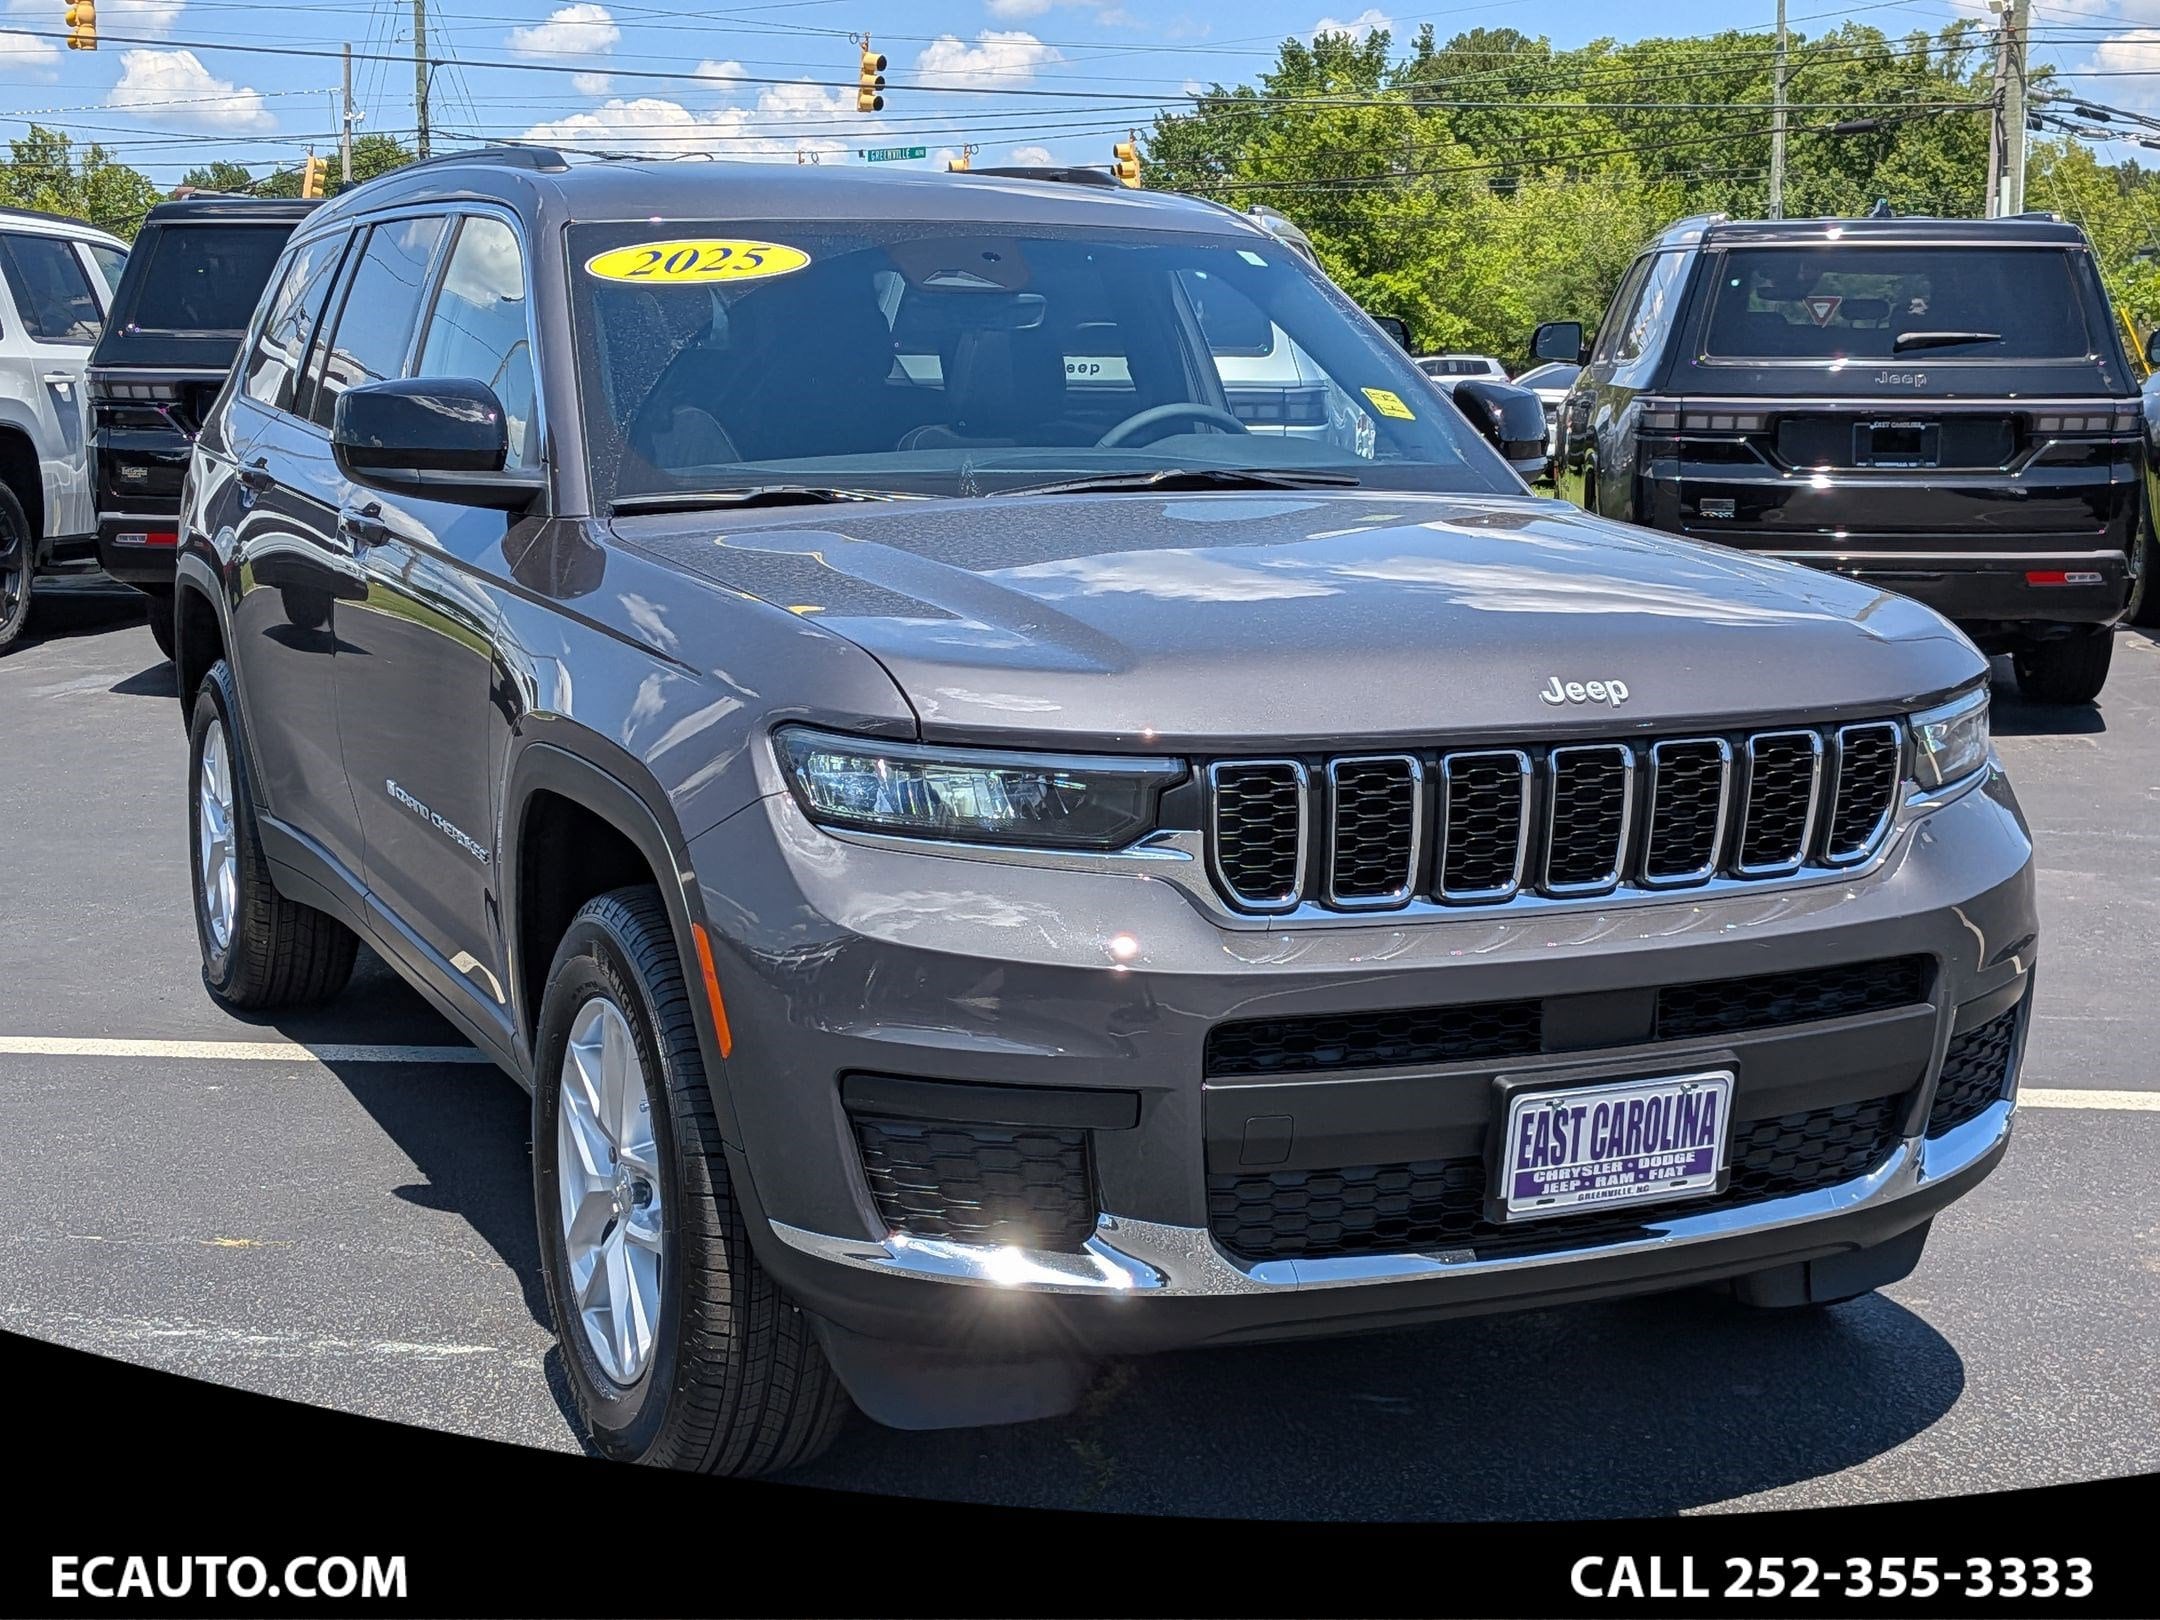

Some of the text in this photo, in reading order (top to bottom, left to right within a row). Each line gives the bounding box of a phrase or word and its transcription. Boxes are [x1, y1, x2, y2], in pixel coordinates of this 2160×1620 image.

[871, 148, 911, 161] GREENVILLE
[624, 247, 772, 278] 2025
[1066, 363, 1100, 376] eep
[1874, 371, 1927, 388] Jeep
[1540, 676, 1629, 708] Jeep
[1517, 1090, 1718, 1169] EAST CAROLINA
[1533, 1151, 1696, 1183] CHRYSLER DODGE
[1541, 1165, 1687, 1195] JEEP RAM FIAT
